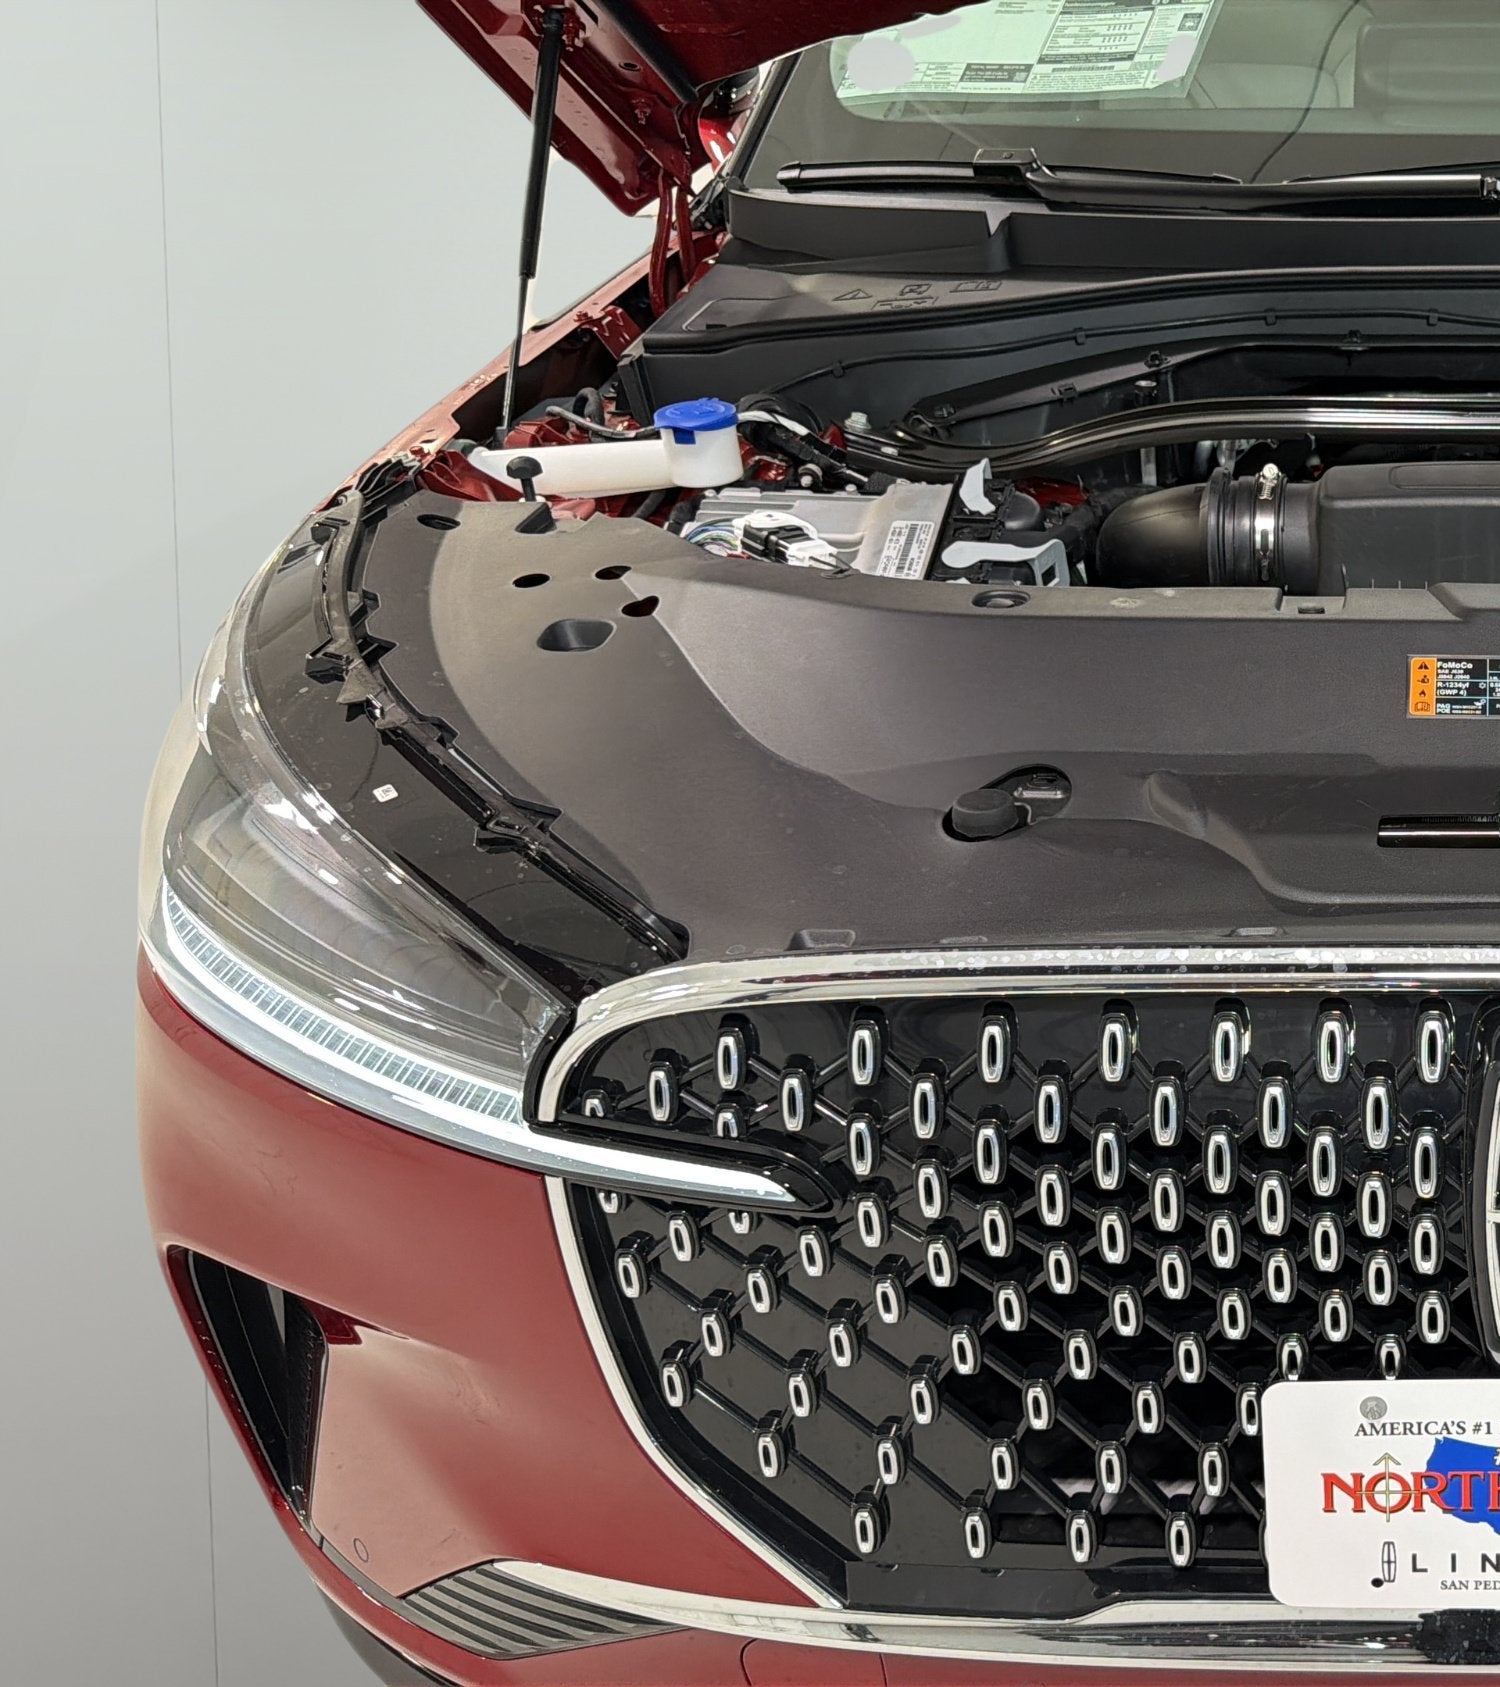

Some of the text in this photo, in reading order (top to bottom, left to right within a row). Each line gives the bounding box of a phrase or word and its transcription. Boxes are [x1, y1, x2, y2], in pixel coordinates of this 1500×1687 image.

[1437, 661, 1473, 669] FoMoCo
[1459, 689, 1467, 697] 4)
[1354, 1420, 1467, 1437] AMERICA'S
[1472, 1421, 1493, 1436] #1
[1440, 1579, 1470, 1591] SAN
